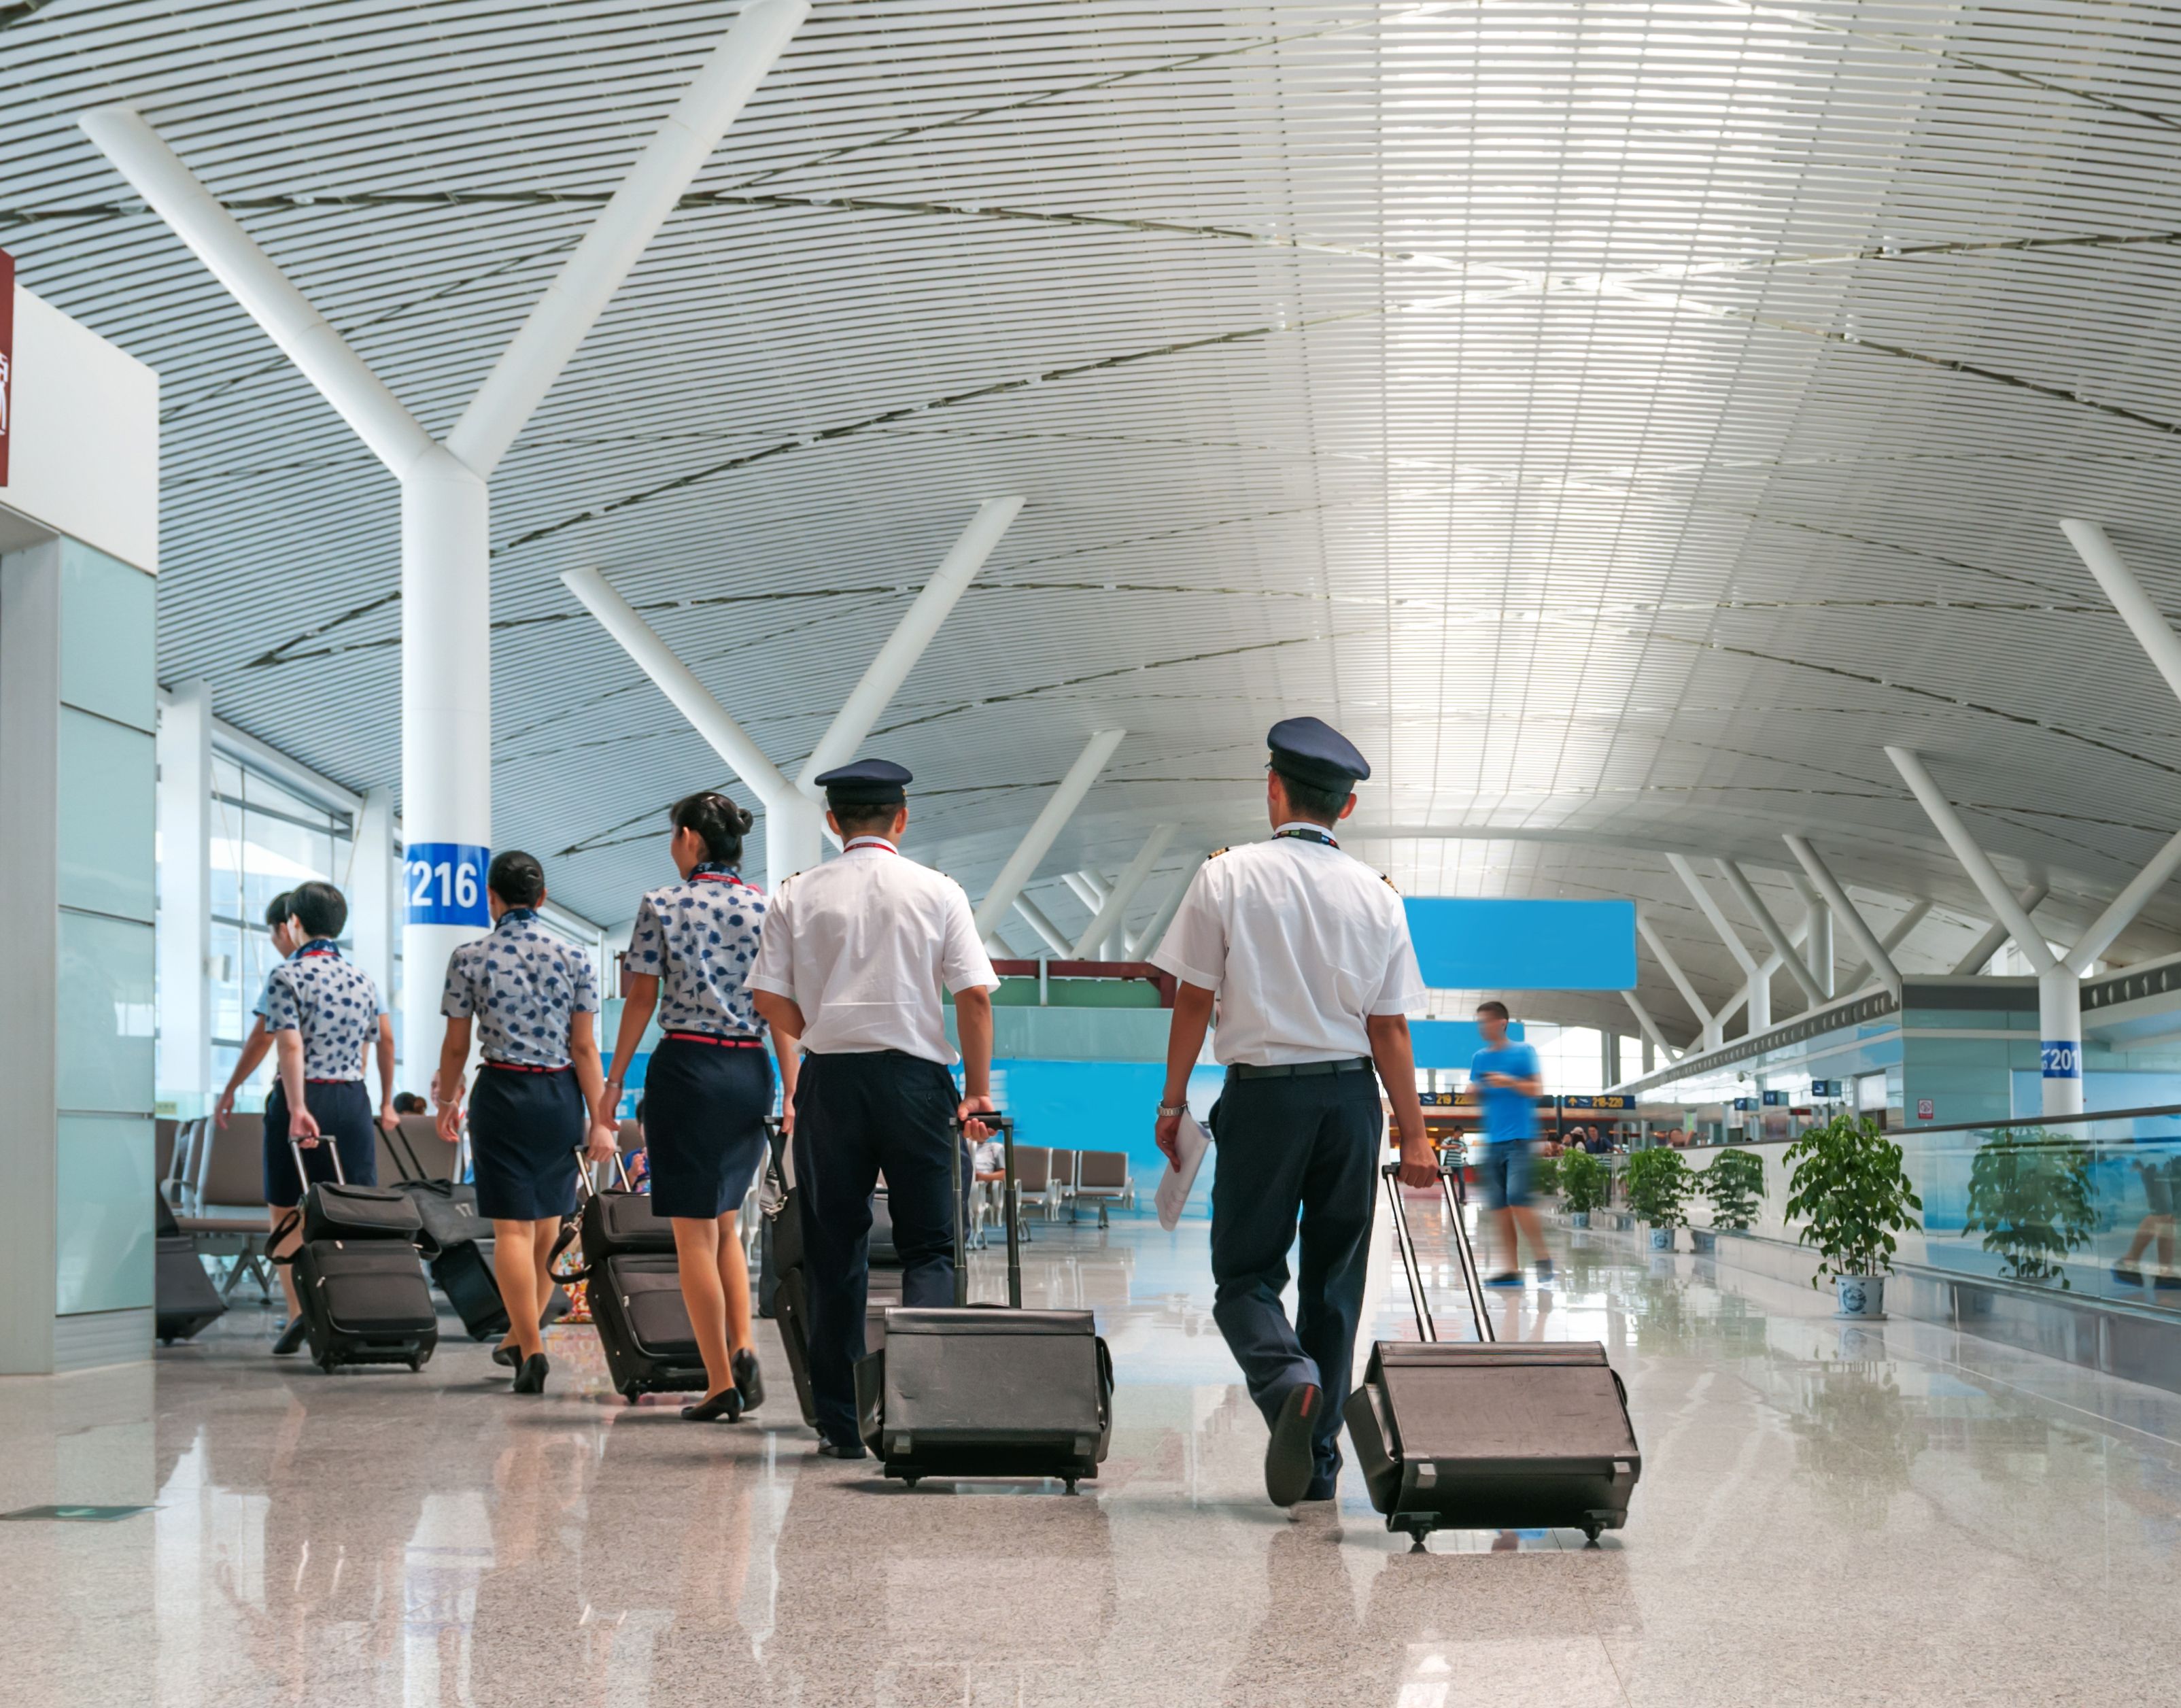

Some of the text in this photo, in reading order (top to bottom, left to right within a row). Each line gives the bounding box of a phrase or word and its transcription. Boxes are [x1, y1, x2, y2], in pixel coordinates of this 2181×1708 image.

[411, 860, 478, 908] 216
[2050, 1048, 2078, 1071] 201
[455, 1203, 474, 1217] 17
